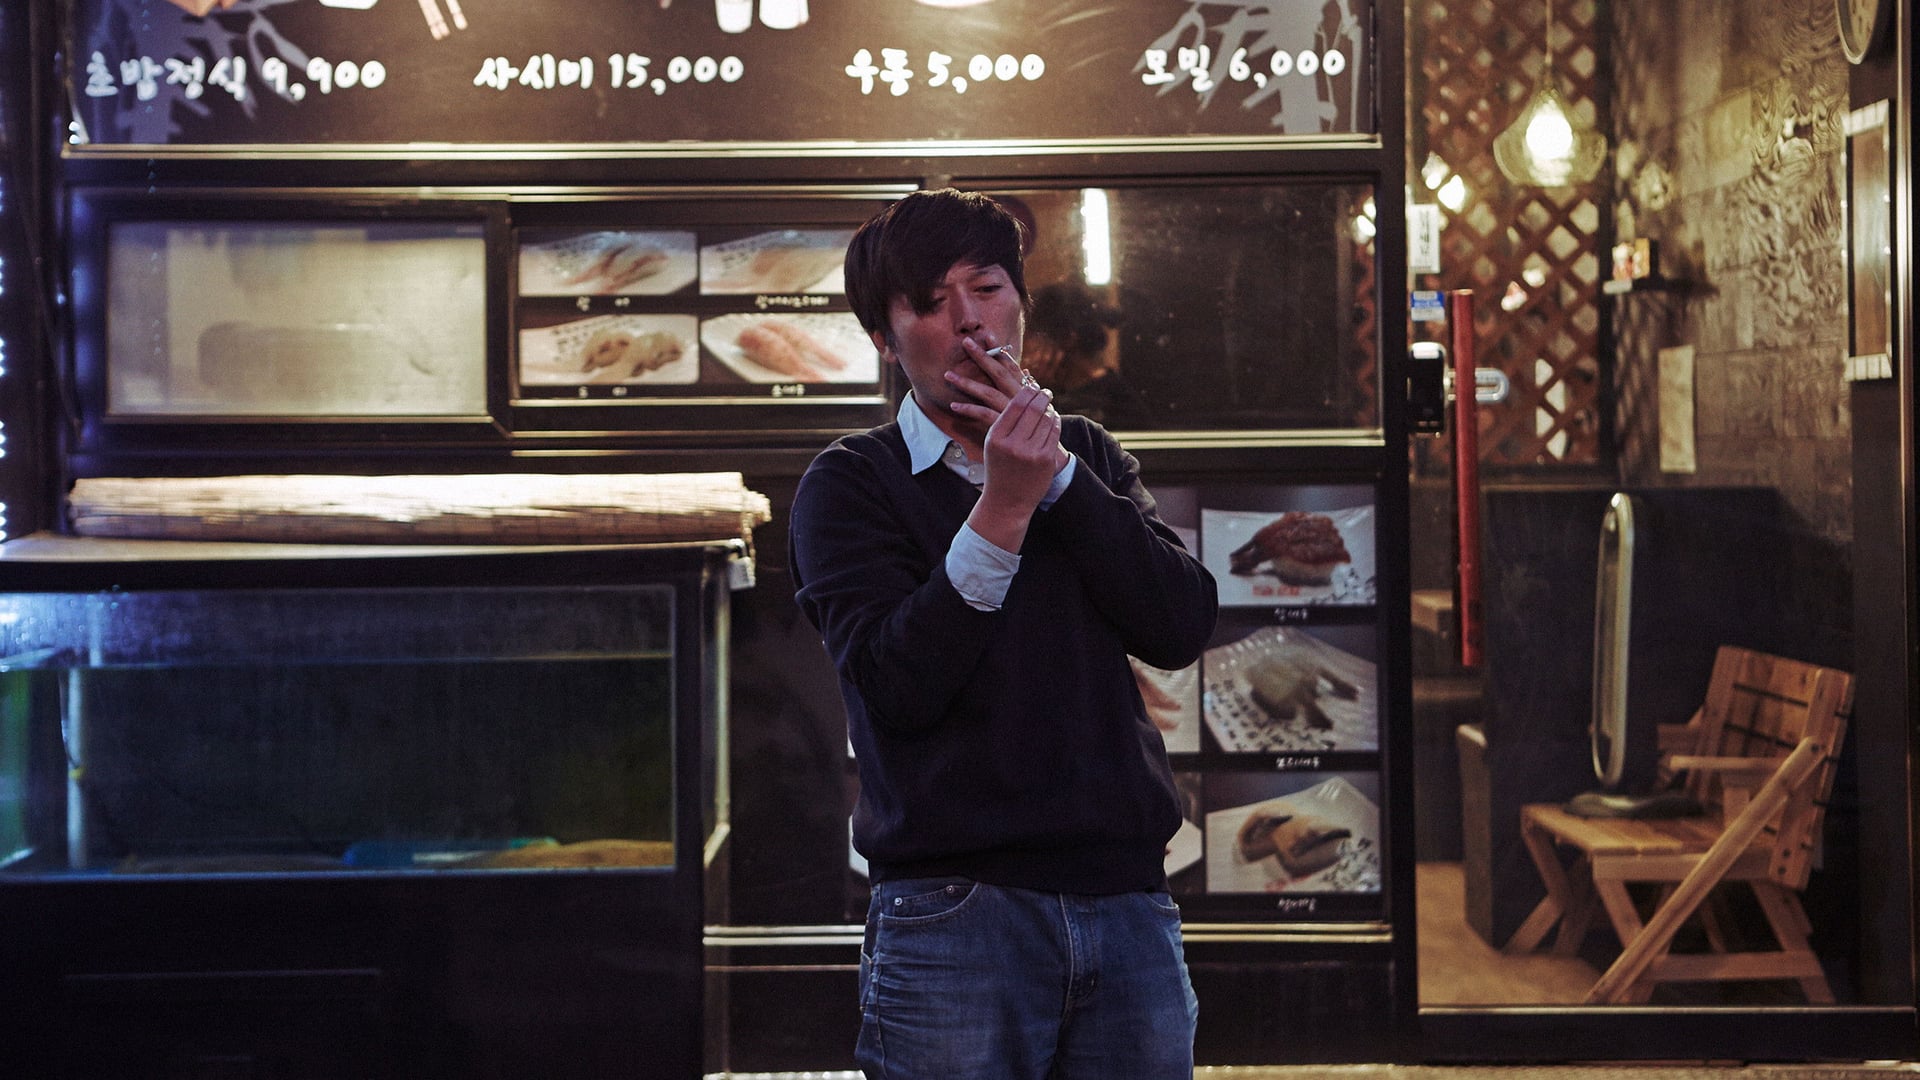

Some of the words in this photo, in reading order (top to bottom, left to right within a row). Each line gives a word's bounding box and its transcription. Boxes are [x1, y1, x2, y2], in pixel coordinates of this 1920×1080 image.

[85, 51, 246, 100] 초밥정식
[261, 56, 387, 100] 9,900
[473, 53, 594, 90] 사시미
[608, 53, 744, 96] 15,000
[844, 48, 914, 97] 우동
[927, 50, 1045, 95] 5,000
[1141, 44, 1214, 93] 모밀
[1229, 47, 1346, 89] 6,000
